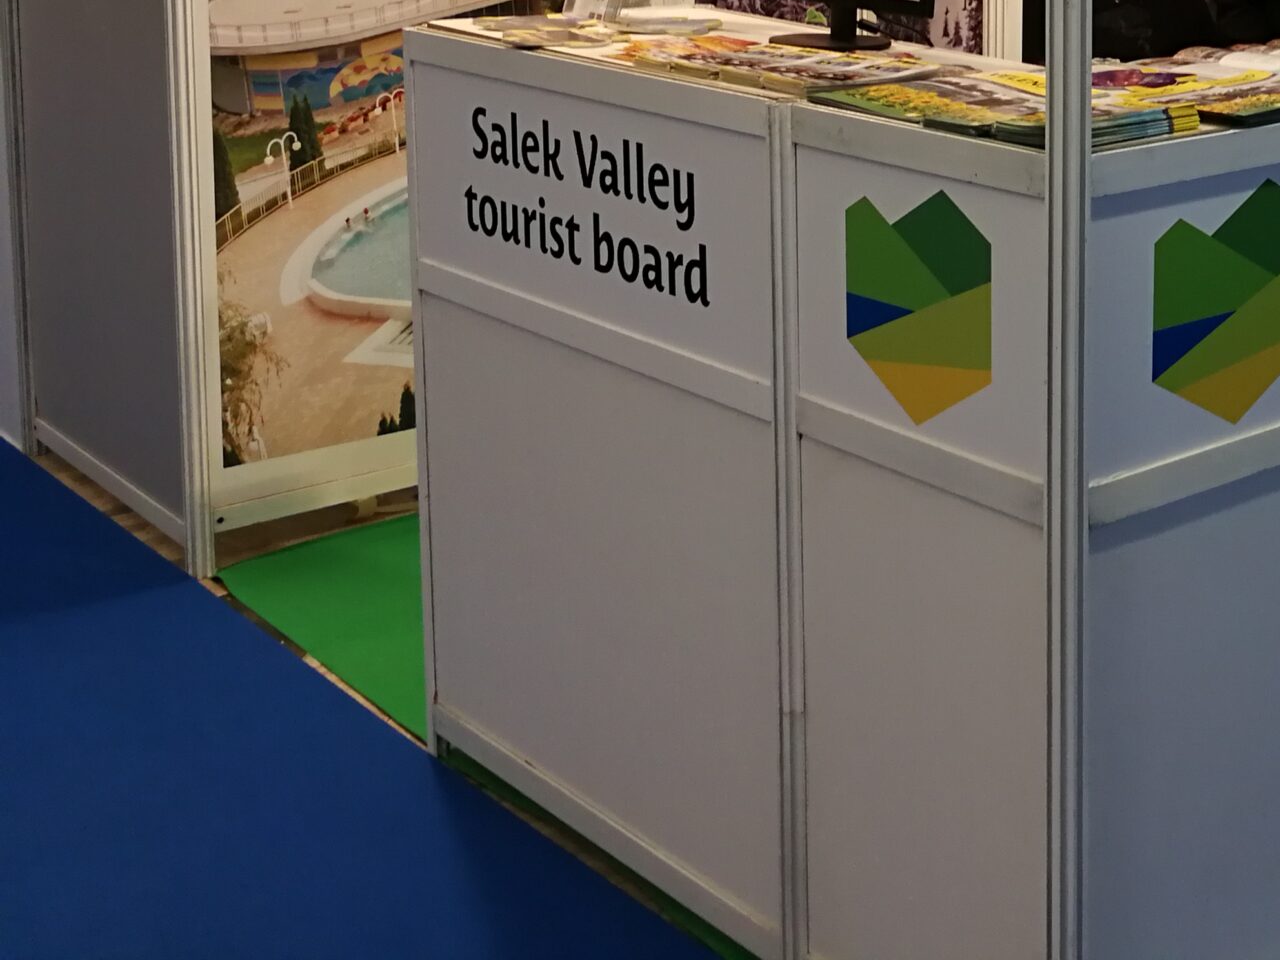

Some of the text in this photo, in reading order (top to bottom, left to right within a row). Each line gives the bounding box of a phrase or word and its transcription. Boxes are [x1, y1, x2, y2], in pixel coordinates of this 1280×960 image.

[472, 106, 695, 231] Salek Valley
[464, 184, 710, 308] tourist board
